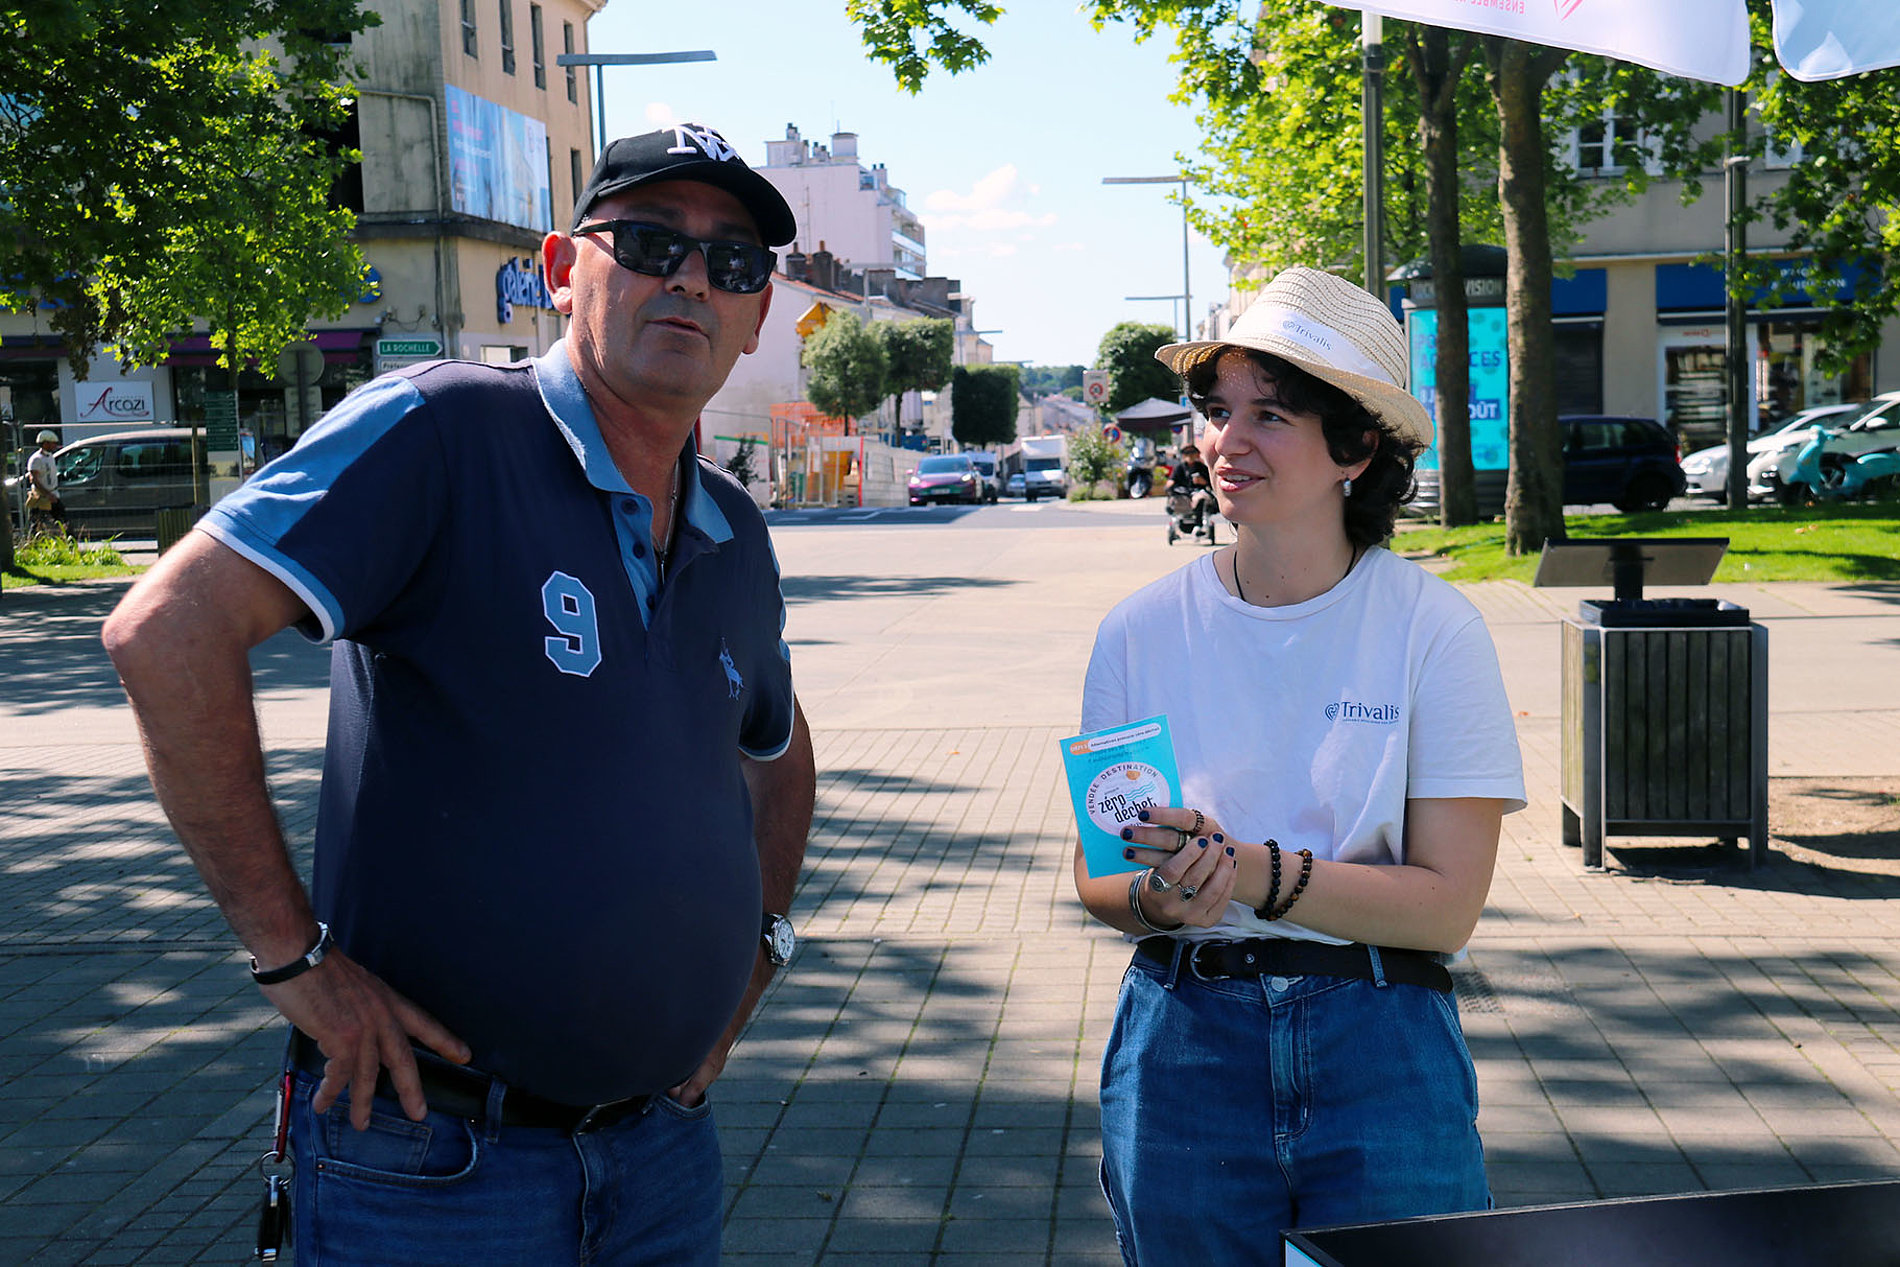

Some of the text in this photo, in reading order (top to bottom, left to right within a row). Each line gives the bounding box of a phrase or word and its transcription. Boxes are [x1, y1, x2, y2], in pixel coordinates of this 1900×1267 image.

[382, 343, 430, 353] LA ROCHELLE
[1296, 325, 1334, 351] Trivalis
[542, 570, 602, 678] 9
[1342, 701, 1400, 720] Trivalis
[1088, 764, 1158, 815] VENDÉE DESTINATION
[1098, 794, 1127, 814] zéro
